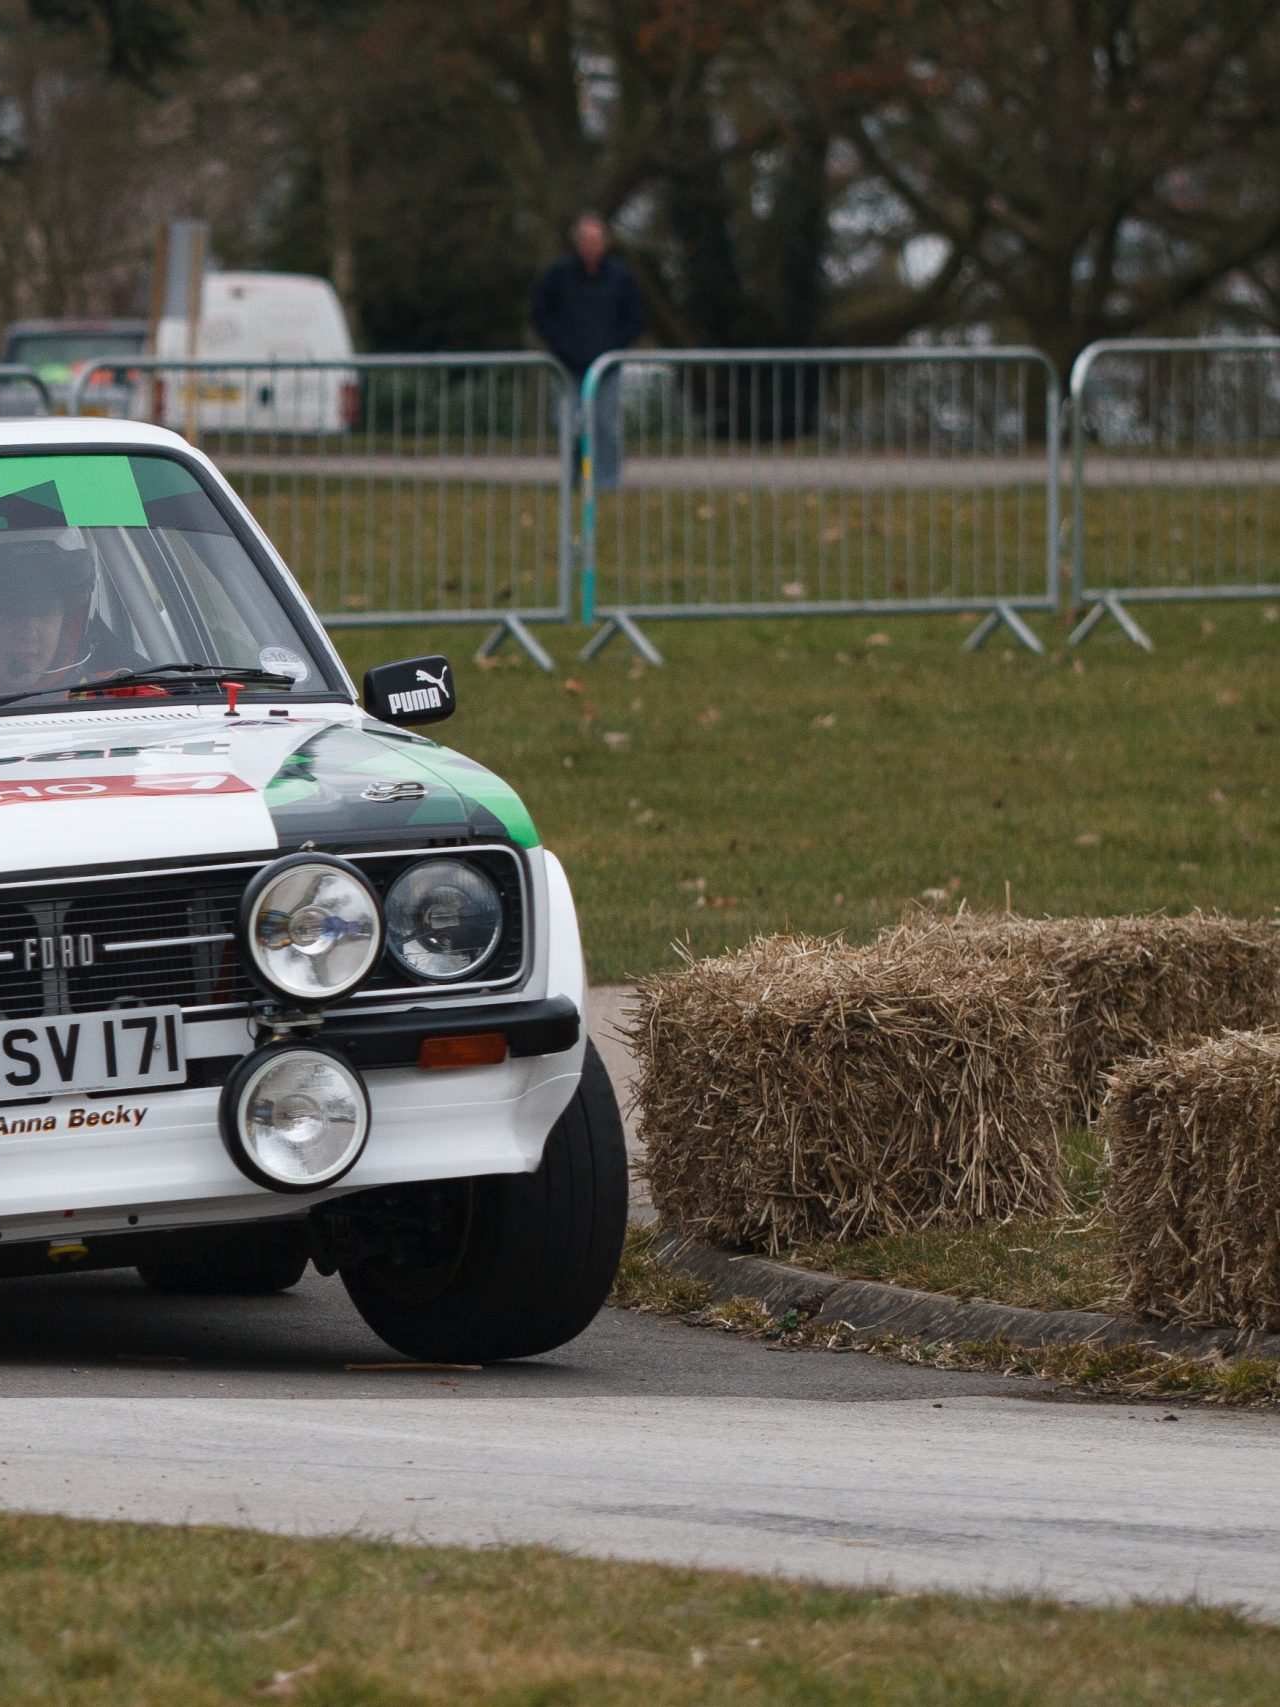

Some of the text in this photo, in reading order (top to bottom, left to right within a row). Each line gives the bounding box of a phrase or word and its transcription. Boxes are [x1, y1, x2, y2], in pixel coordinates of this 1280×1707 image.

[388, 687, 442, 715] PUMA
[24, 934, 94, 971] FORD
[102, 1014, 180, 1078] 171
[67, 1104, 149, 1130] Becky
